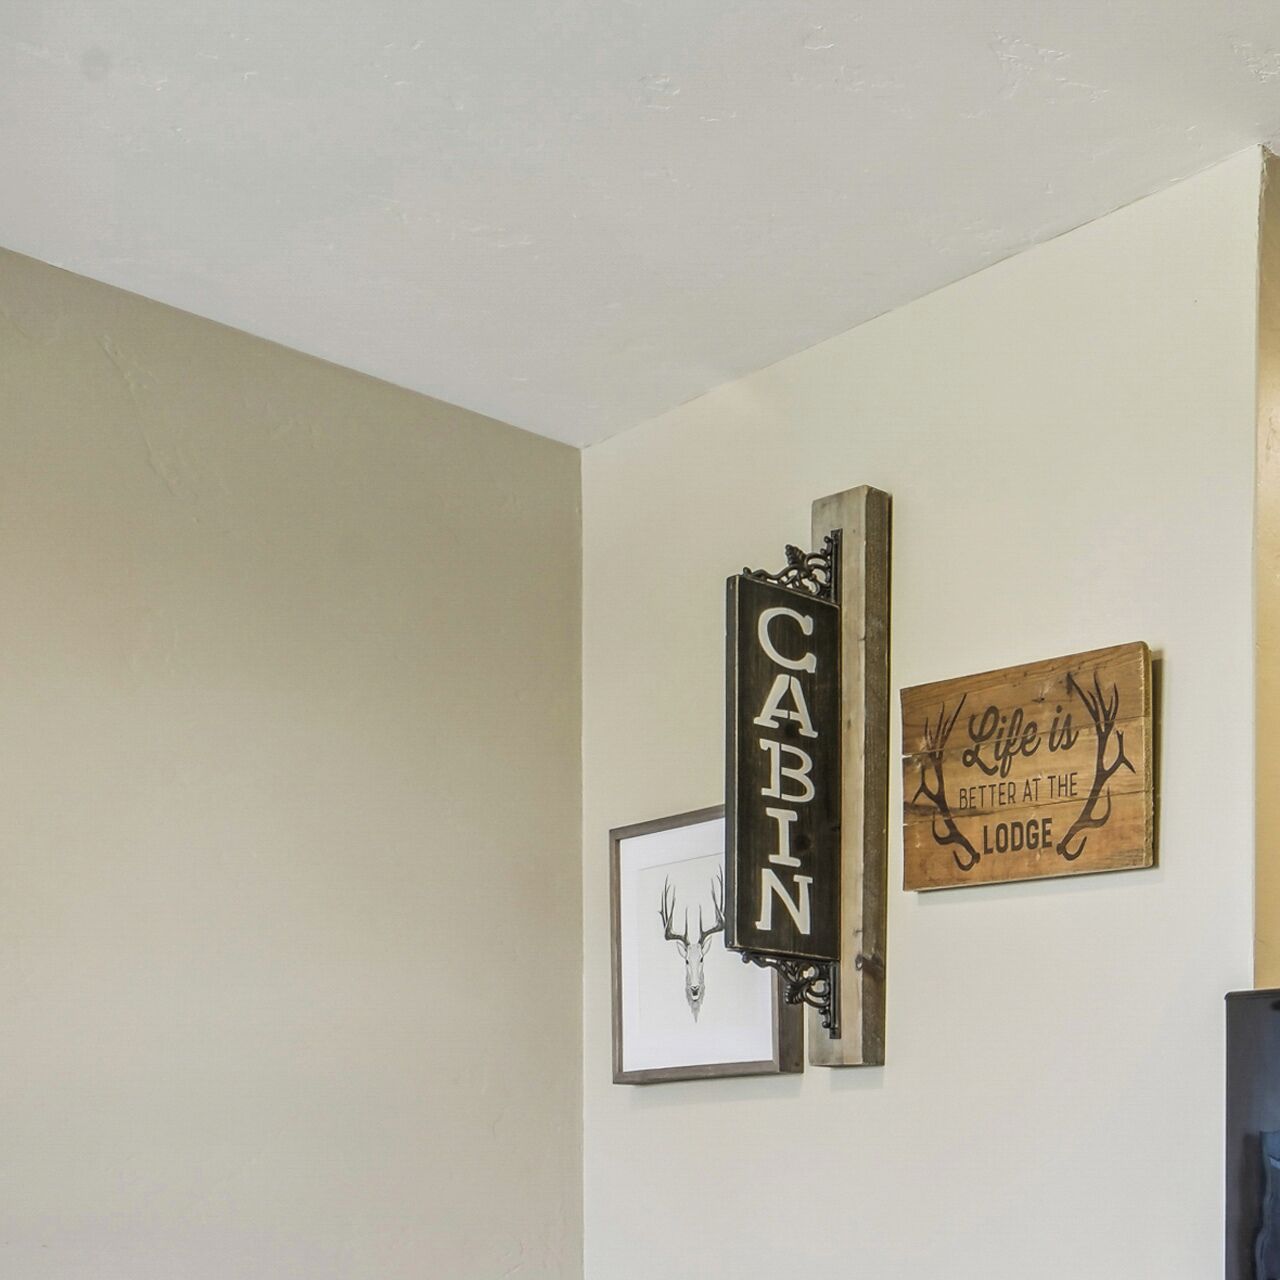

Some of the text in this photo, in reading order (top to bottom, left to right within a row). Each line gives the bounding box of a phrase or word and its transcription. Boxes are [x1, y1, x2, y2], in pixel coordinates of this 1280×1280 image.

[753, 605, 819, 935] CABIN
[961, 704, 1079, 779] Life is
[958, 771, 1079, 811] BETTER AT THE
[982, 817, 1053, 856] LODGE
